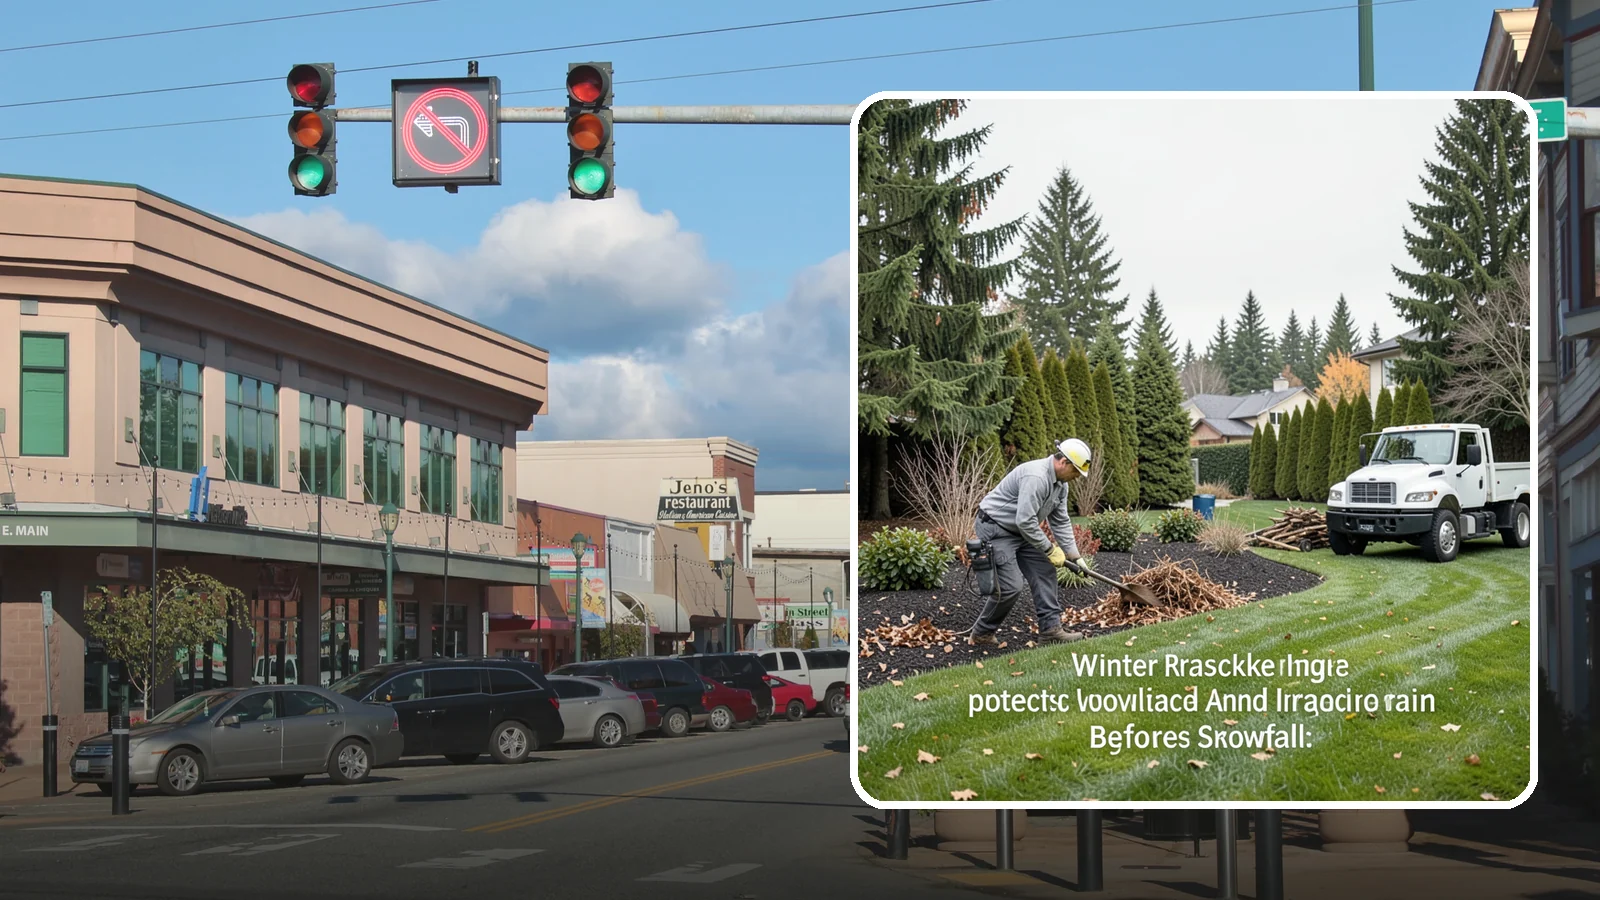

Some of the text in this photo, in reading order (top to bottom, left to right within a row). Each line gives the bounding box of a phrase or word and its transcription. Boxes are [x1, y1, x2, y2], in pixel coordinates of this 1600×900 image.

[669, 480, 727, 494] Jeno's
[665, 496, 731, 509] restaurant
[658, 510, 681, 519] Italian
[686, 510, 714, 519] American
[715, 510, 737, 519] Cuisine
[2, 525, 49, 536] E. MAIN
[797, 607, 828, 617] Street
